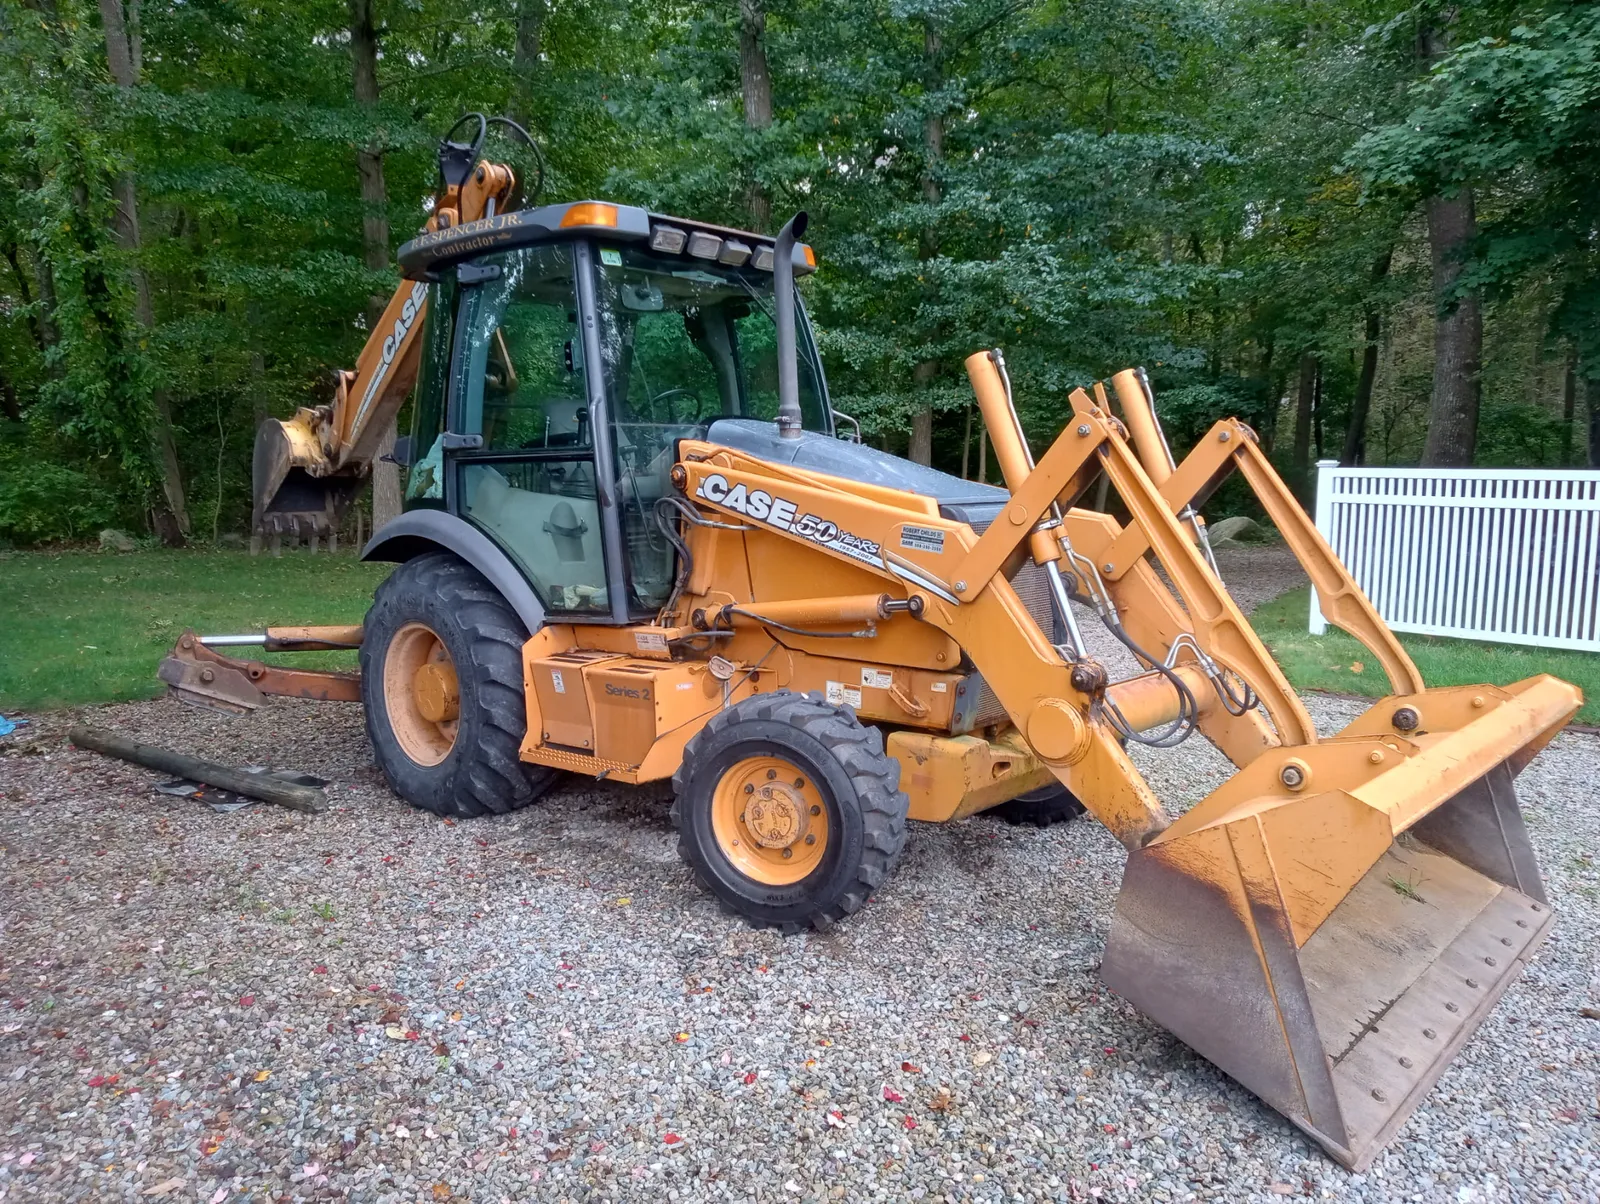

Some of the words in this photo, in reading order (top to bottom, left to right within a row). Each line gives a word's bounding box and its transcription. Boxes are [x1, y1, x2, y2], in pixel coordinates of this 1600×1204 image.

[430, 219, 494, 243] SPENCER
[498, 214, 522, 229] JR.
[432, 235, 494, 257] Contractor
[382, 280, 428, 365] CASE
[702, 473, 798, 532] CASE
[795, 513, 838, 543] 50
[839, 529, 881, 555] YEARS
[902, 526, 920, 535] ROBERT
[604, 683, 640, 699] Series
[642, 688, 651, 700] 2
